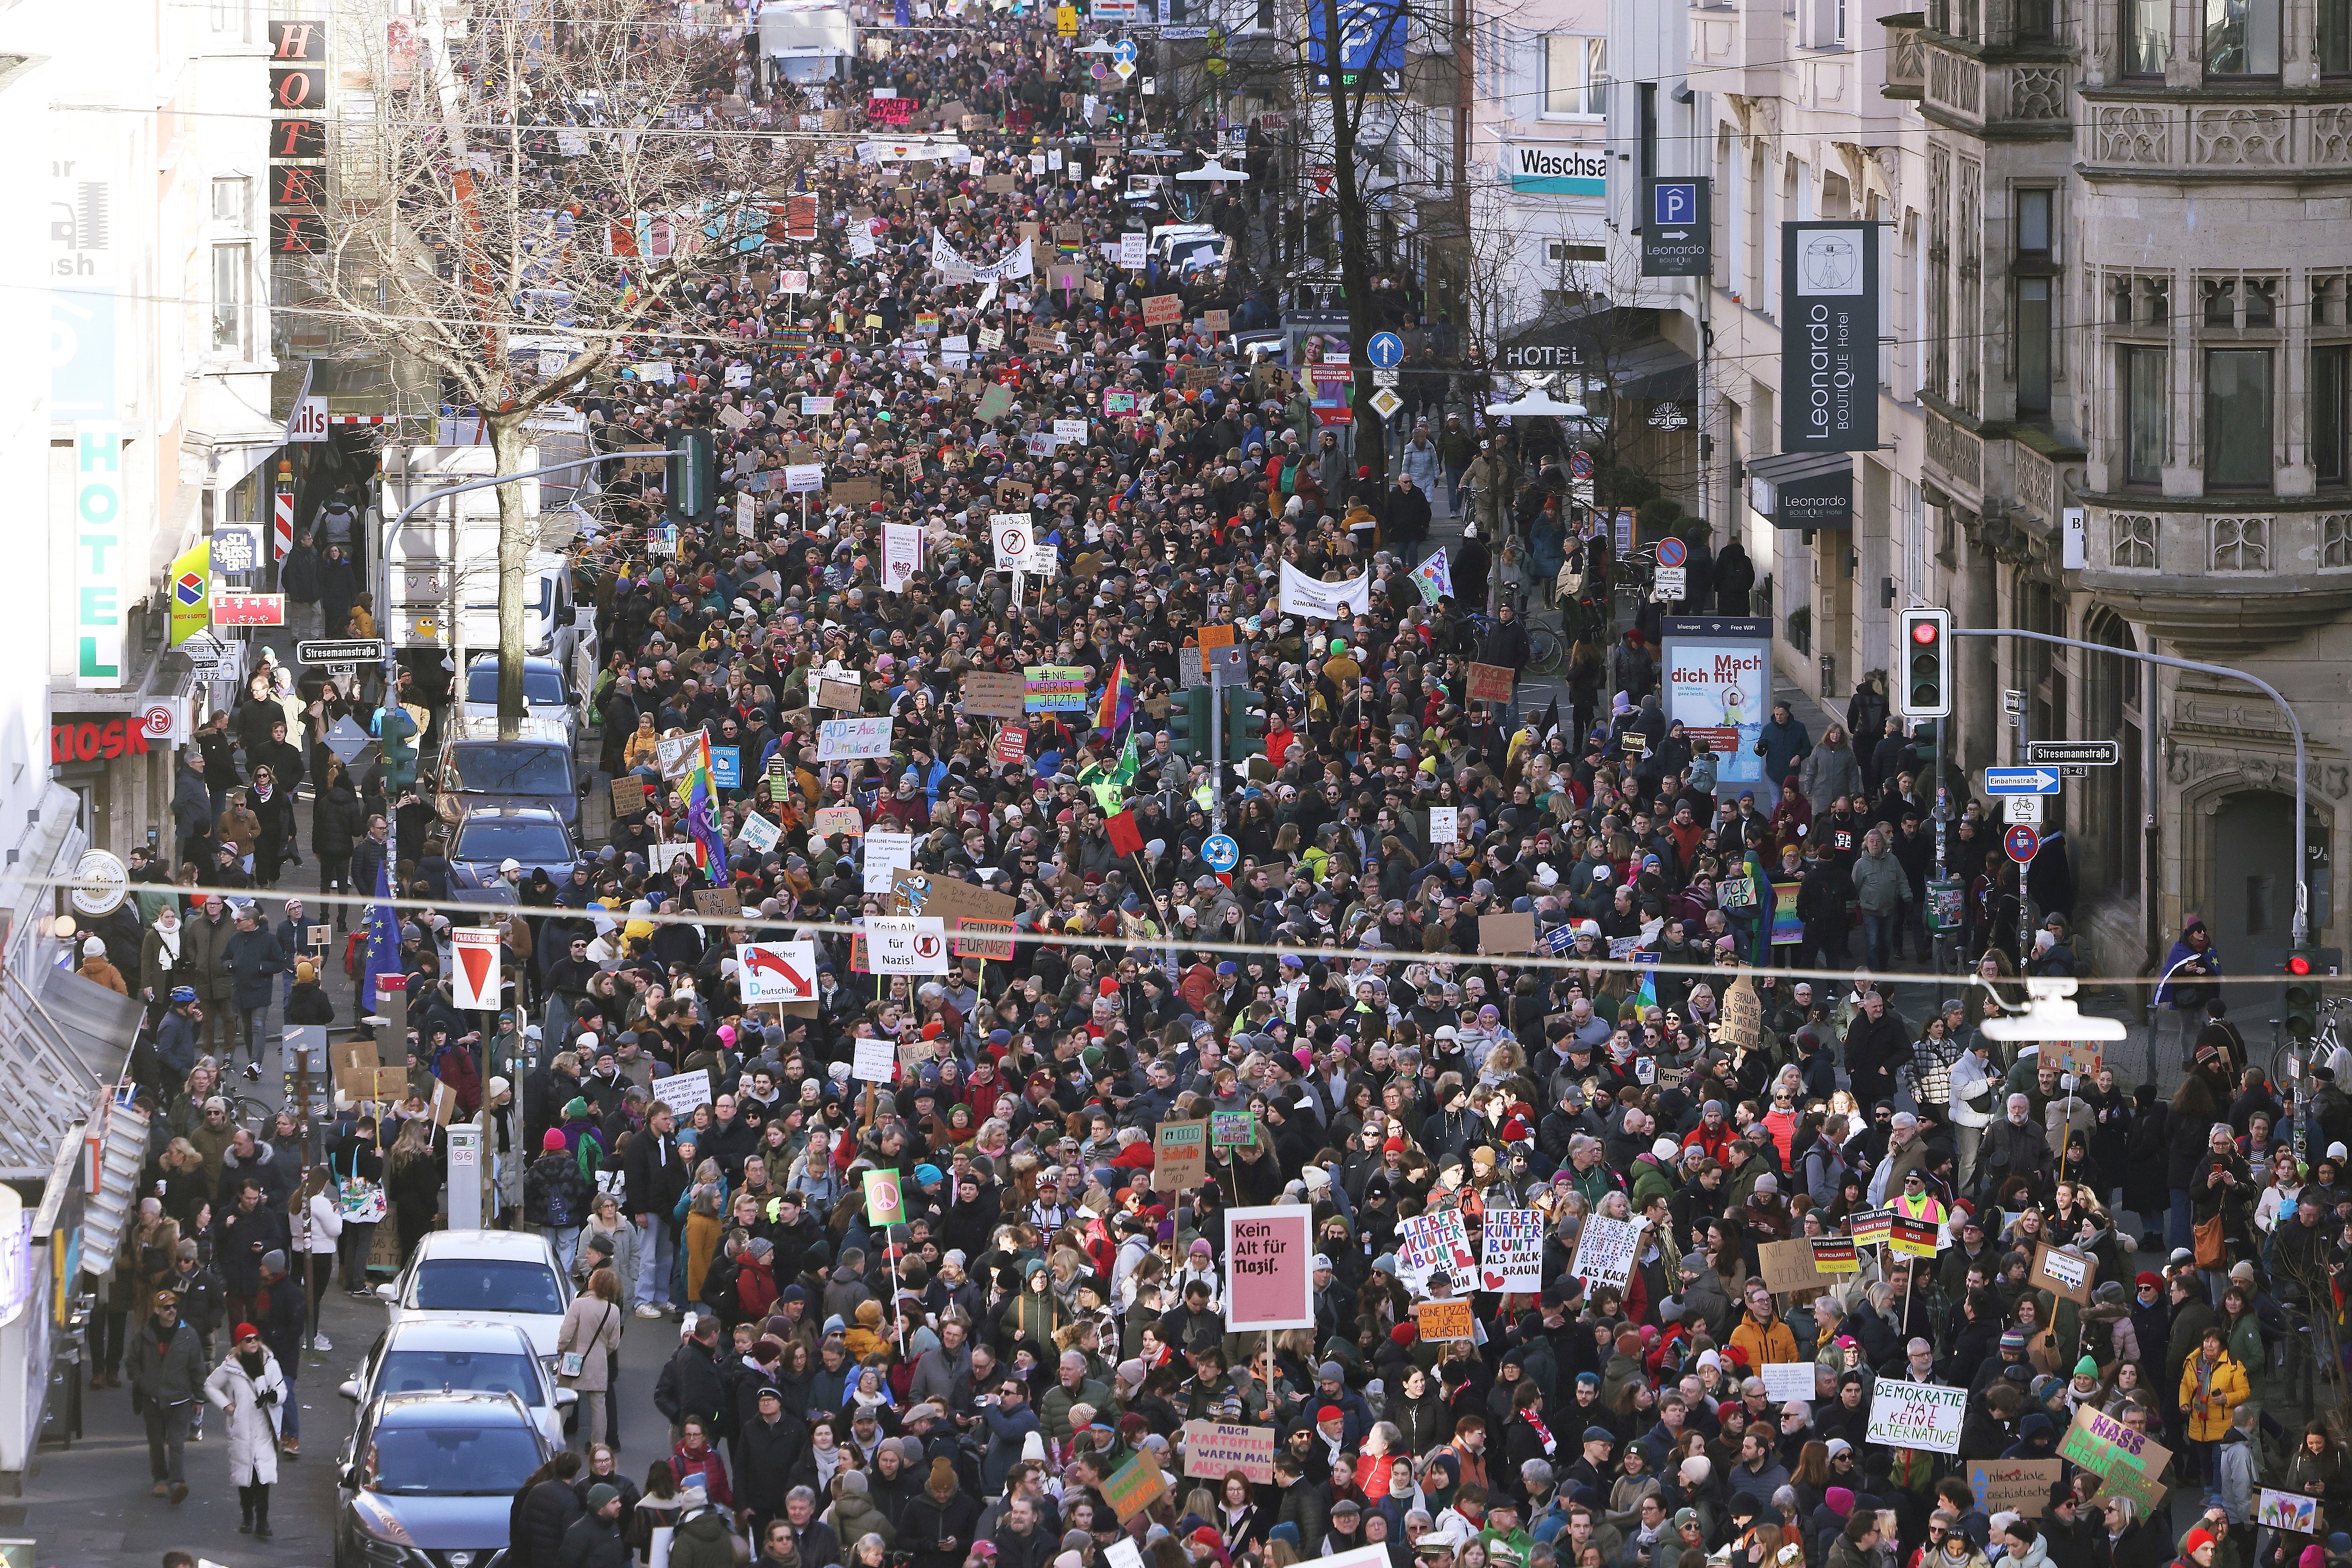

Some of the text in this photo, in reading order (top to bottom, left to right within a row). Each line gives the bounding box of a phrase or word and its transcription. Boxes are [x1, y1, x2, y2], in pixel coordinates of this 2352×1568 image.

[276, 25, 313, 251] HOTEL
[1521, 149, 1606, 176] Waschsa
[1647, 244, 1704, 256] Leonardo
[52, 253, 94, 275] sh
[1659, 256, 1692, 266] BOUTIQUE
[1507, 346, 1584, 365] HOTEL
[1806, 304, 1828, 438] Leonardo
[1834, 312, 1855, 429] BOUTIQUE Hotel
[1786, 495, 1846, 506] Leonardo
[1790, 508, 1824, 518] BOUTIQUE
[648, 529, 675, 543] BUNT
[651, 539, 674, 553] statt
[80, 433, 118, 677] HOTEL
[893, 561, 911, 572] HERZ
[1292, 599, 1327, 611] DEMOKRATIE
[306, 647, 376, 658] Stresemannstraße
[1181, 665, 1201, 674] STATT
[1715, 655, 1762, 671] Mach
[1672, 667, 1738, 683] dich fit!
[1030, 682, 1057, 694] WIEDER
[1061, 682, 1073, 692] IST
[1479, 679, 1507, 690] EUNT
[1039, 694, 1078, 708] JETZT!
[1473, 687, 1509, 701] DOMUS
[821, 721, 847, 738] AfD
[856, 721, 875, 735] Aus
[876, 722, 888, 734] für
[823, 738, 880, 755] Demokratie
[2038, 747, 2111, 761] Stresemannstraße
[1990, 777, 2039, 786] Einbahnstraße
[824, 817, 851, 826] SIND
[1723, 880, 1747, 894] FCK
[697, 892, 720, 902] KEIN
[951, 887, 989, 902] Die AFD
[1726, 894, 1749, 907] AFD
[710, 899, 725, 909] ALT
[455, 934, 498, 943] PARKSCHEINE
[888, 938, 904, 949] für
[745, 947, 796, 960] Arschlöcher
[958, 938, 1012, 956] FÜR NAZIS
[882, 954, 915, 966] Nazis!
[750, 984, 806, 996] Deutschland!
[1734, 992, 1757, 1005] BRAUN
[1732, 1003, 1749, 1015] SIND
[1724, 1026, 1759, 1047] FLASCHEN
[1224, 1124, 1247, 1132] bunte
[1215, 1132, 1250, 1144] Vielfalt
[1162, 1147, 1198, 1161] Schritte
[1170, 1175, 1184, 1184] AfD
[1485, 1211, 1540, 1225] LIEBER
[1856, 1210, 1890, 1222] UNSER LAND
[1235, 1222, 1271, 1238] Kein
[1486, 1224, 1542, 1239] KUNTER-
[1905, 1220, 1924, 1229] WEIDEL
[1235, 1239, 1287, 1257] Alt für
[1489, 1238, 1535, 1252] BUNT
[1486, 1252, 1541, 1265] ALS KACK-
[1502, 1265, 1539, 1276] BRAUN
[2049, 1259, 2081, 1276] keine Meinung!
[1774, 1265, 1810, 1286] JEDEN
[1420, 1304, 1472, 1319] KEINE PIZZEN
[1438, 1317, 1455, 1326] FÜR
[1420, 1324, 1470, 1339] FASCHISTEN
[1876, 1383, 1965, 1406] DEMOKRATIE
[1905, 1401, 1939, 1417] HAT
[1890, 1412, 1937, 1427] KEINE
[1218, 1426, 1249, 1436] AUCH
[1868, 1423, 1957, 1444] ALTERNATIVE
[2090, 1414, 2145, 1455] HASS
[1190, 1434, 1273, 1451] KARTOFFELN
[1198, 1448, 1271, 1464] WAREN MAL
[1110, 1549, 1126, 1561] NEIN
